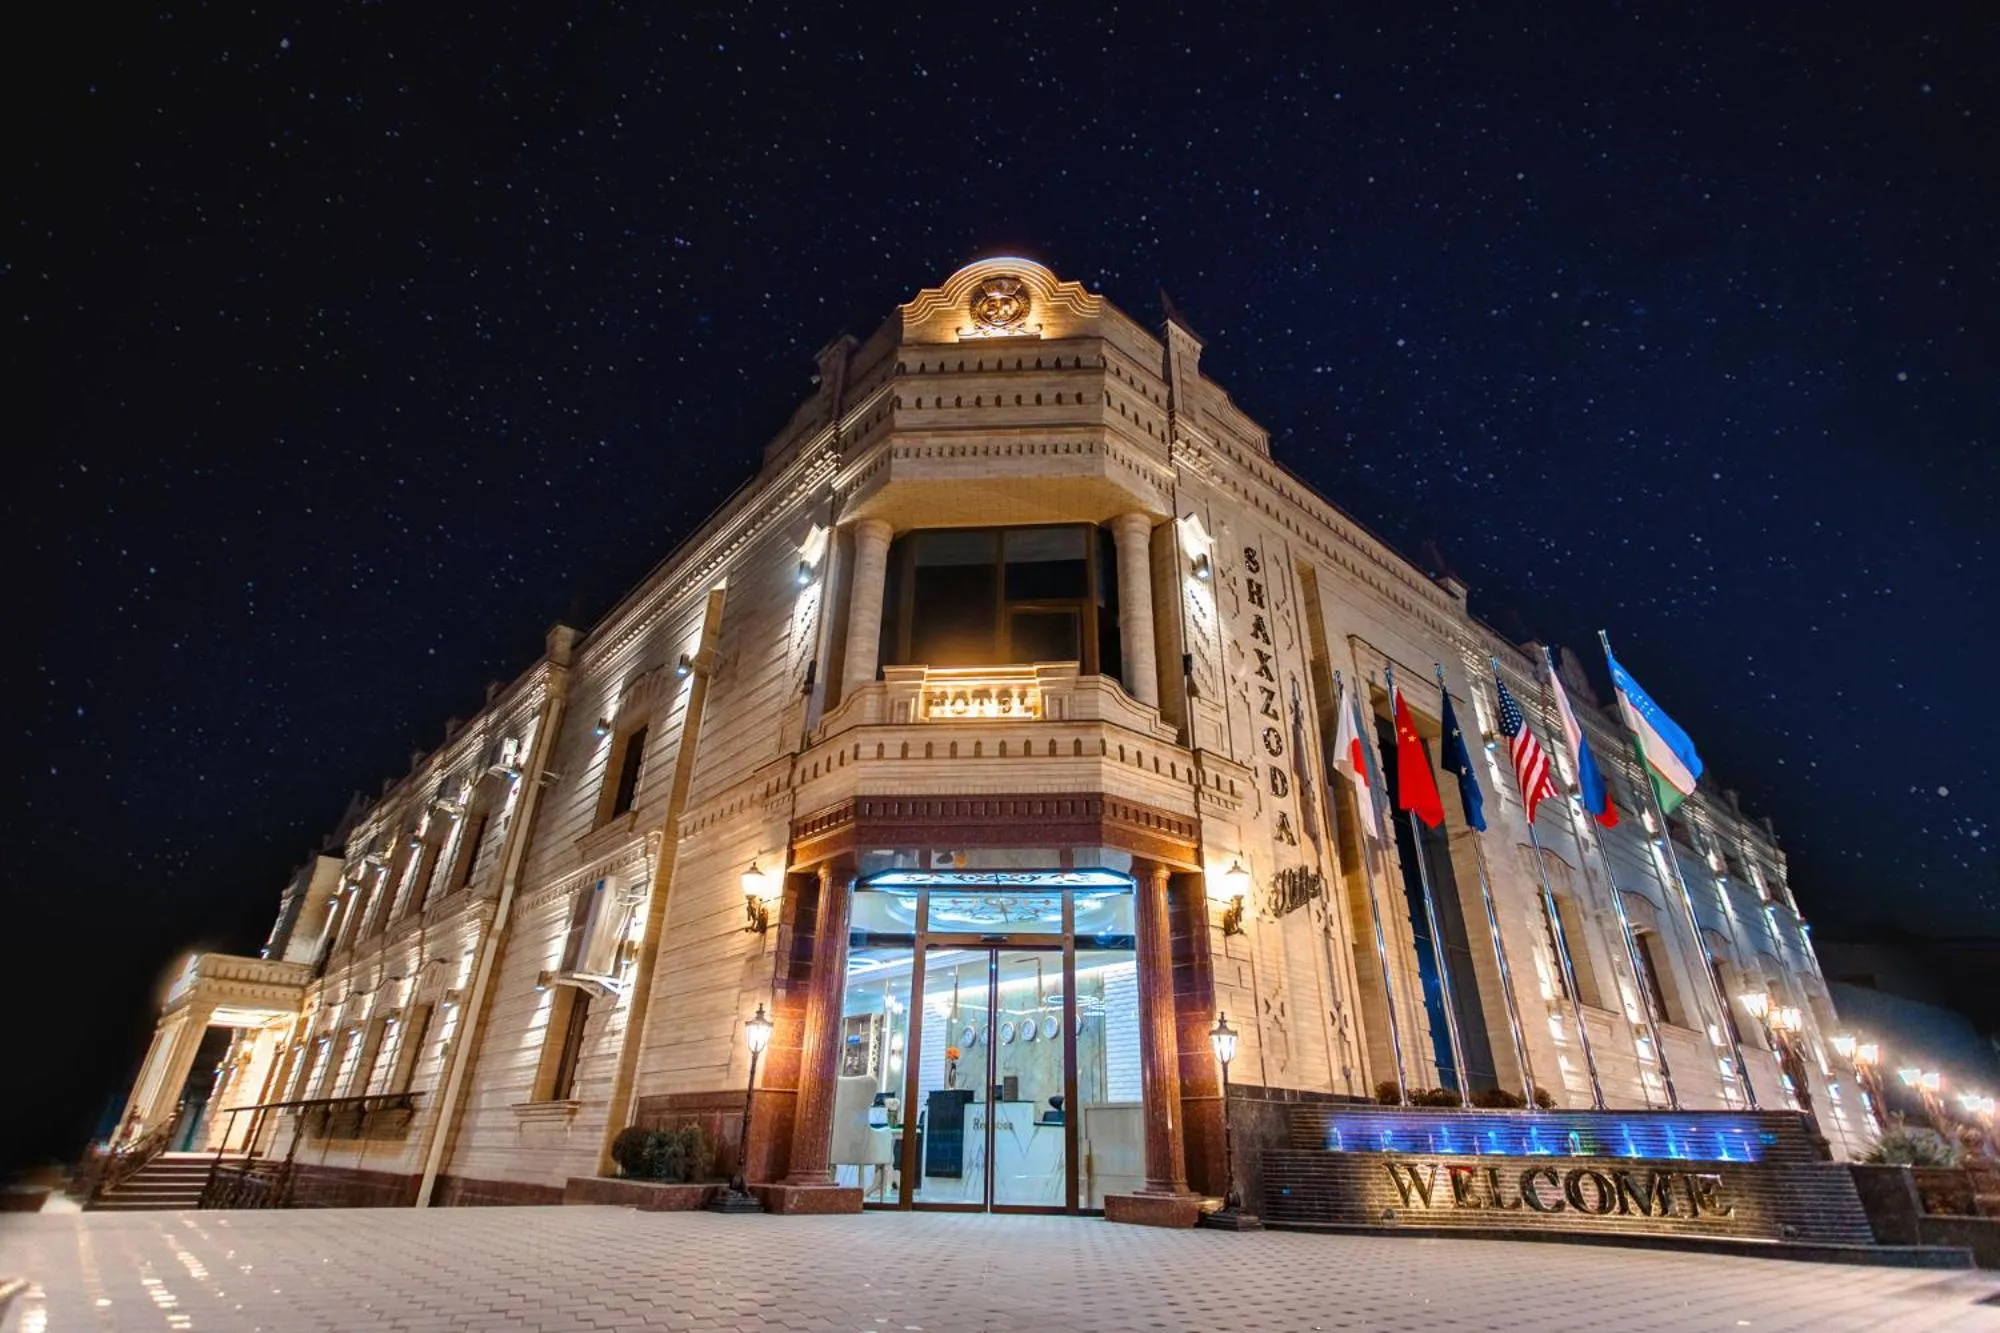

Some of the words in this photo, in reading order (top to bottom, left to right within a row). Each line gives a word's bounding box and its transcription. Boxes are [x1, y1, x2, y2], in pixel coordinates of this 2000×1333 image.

[927, 688, 1033, 715] HOTEL
[1243, 546, 1298, 847] SHAXZODA
[1382, 1162, 1734, 1219] WELCOME
